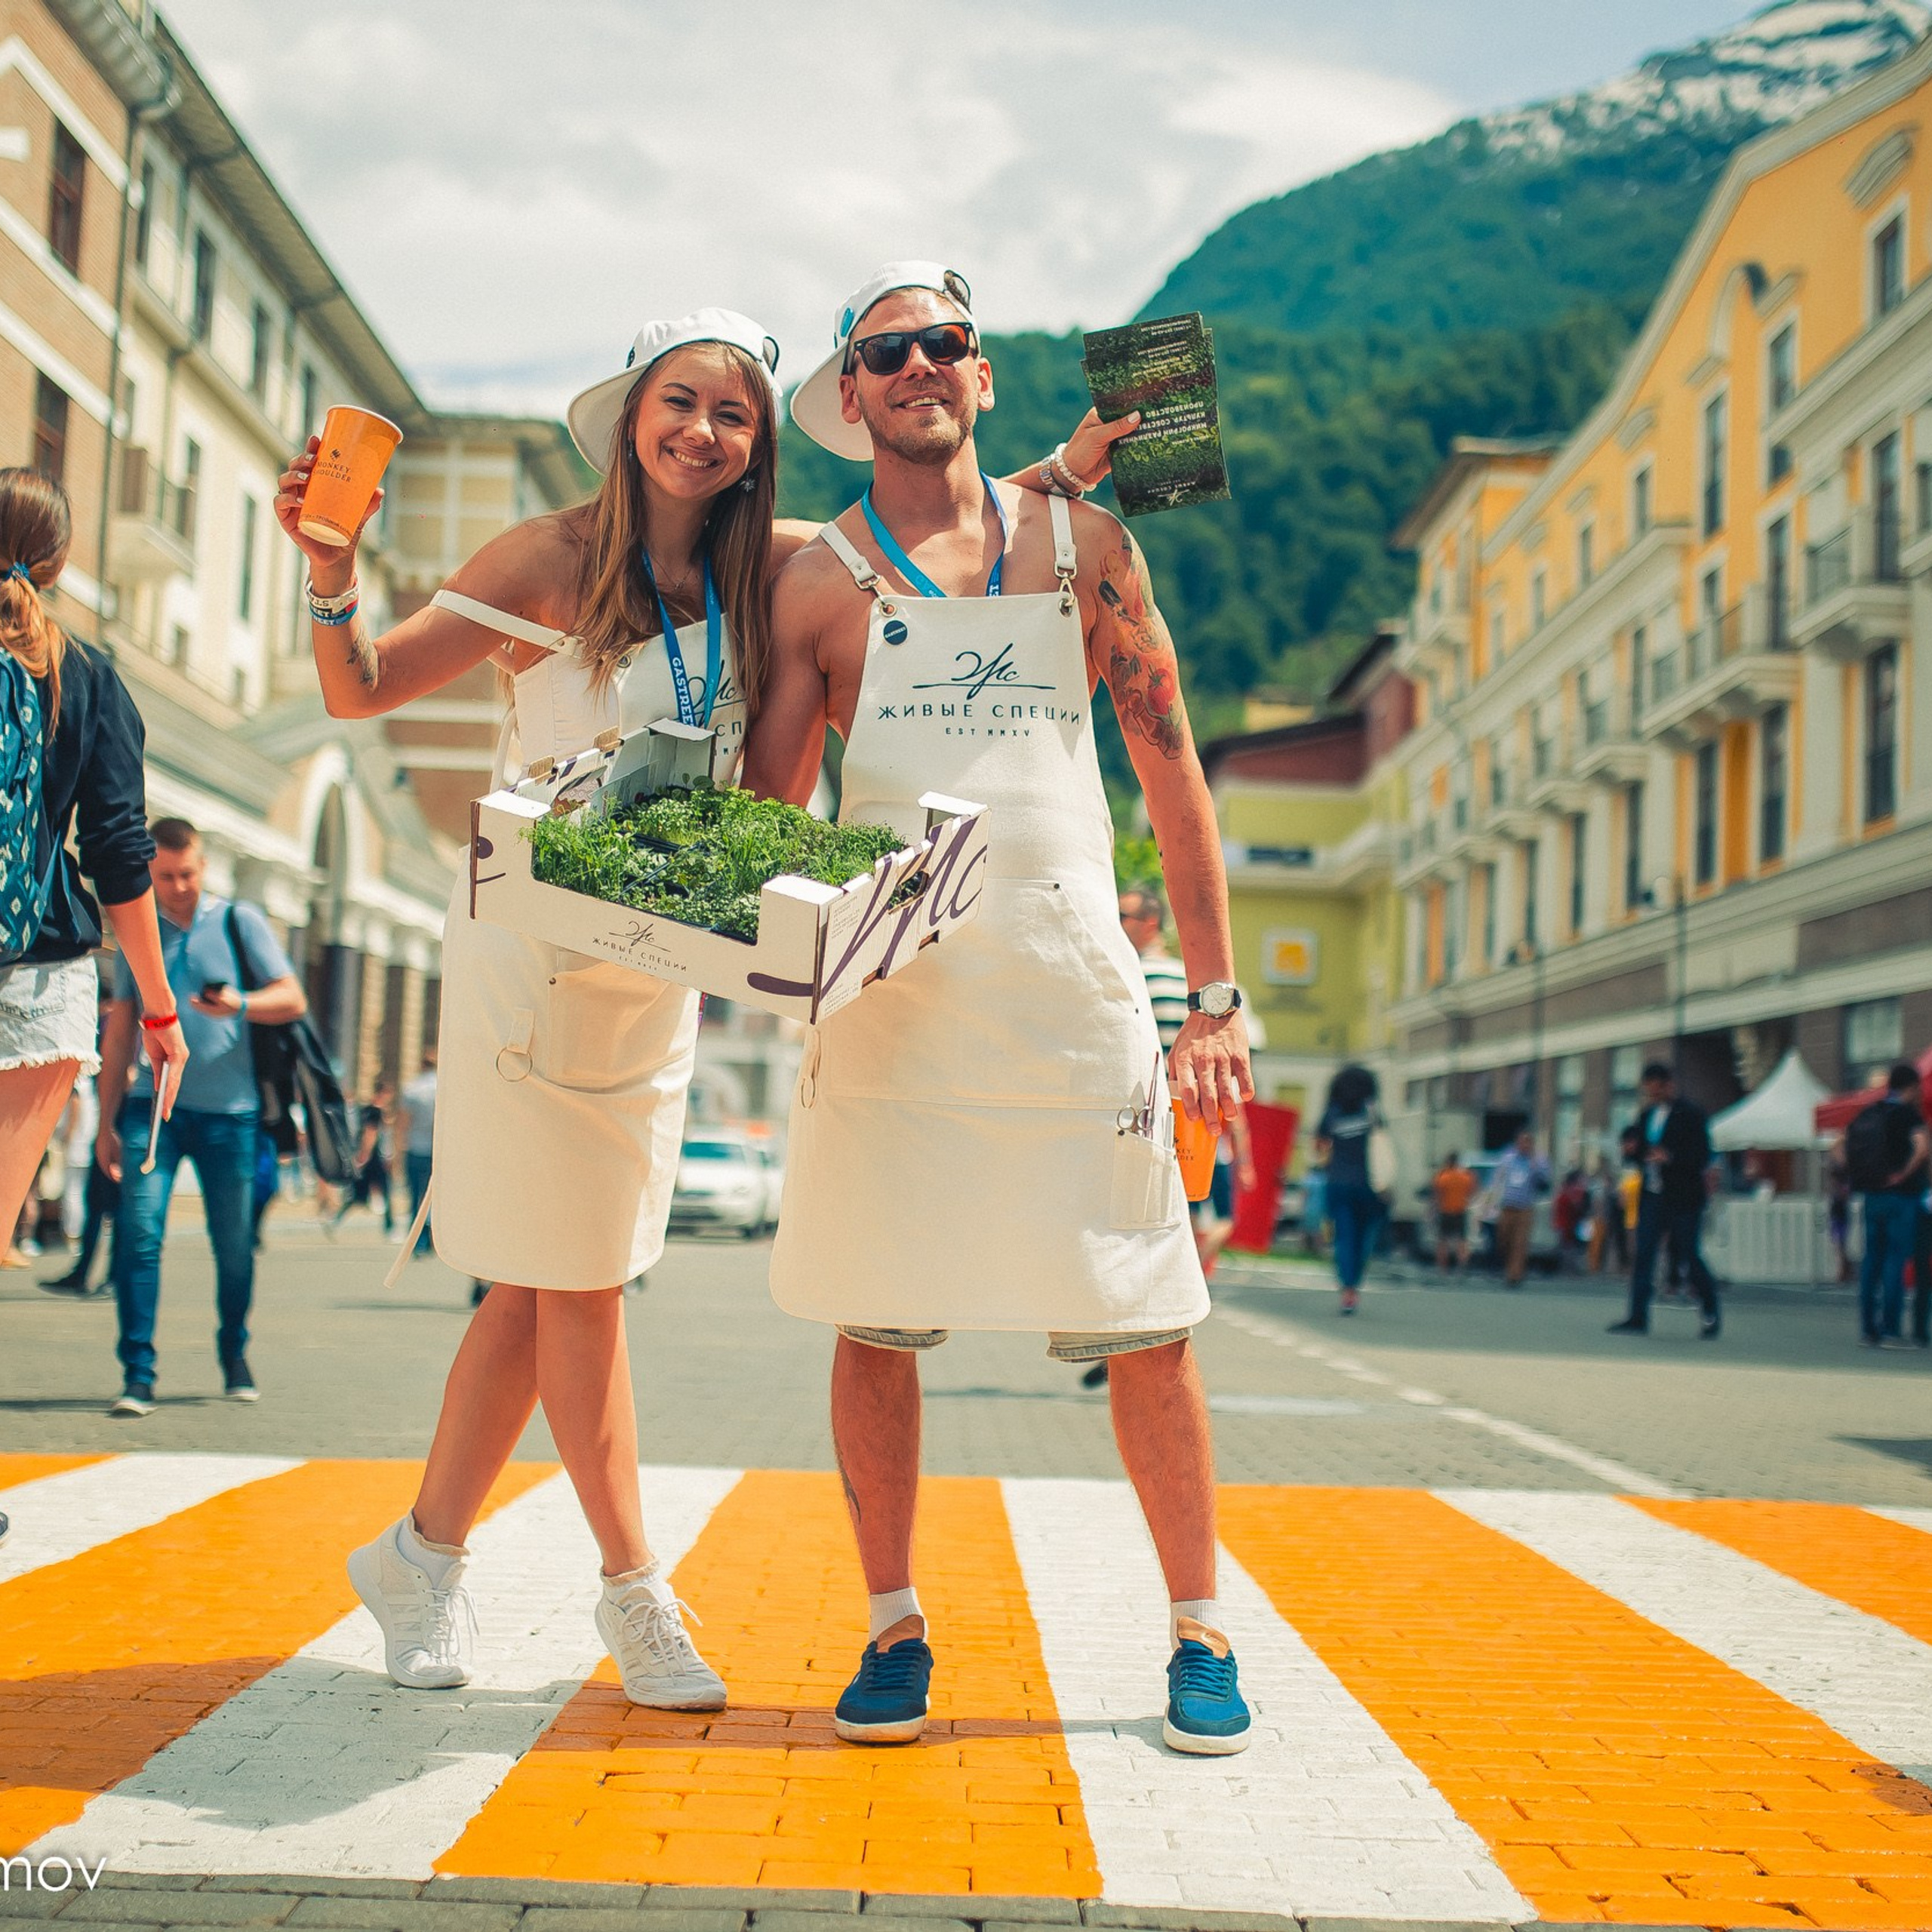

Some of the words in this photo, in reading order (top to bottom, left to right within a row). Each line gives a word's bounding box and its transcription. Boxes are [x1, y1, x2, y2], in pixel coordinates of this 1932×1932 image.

[1145, 401, 1204, 418] ПРОИЗВОДСТВО
[672, 657, 696, 728] GASTREE
[878, 703, 974, 721] ЖИВЫЕ
[991, 703, 1080, 725] СПЕЦИИ
[945, 727, 977, 737] EST
[987, 728, 1031, 738] MMXV
[592, 936, 634, 955] ЖИВЫЕ
[640, 951, 688, 973] СПЕЦИИ
